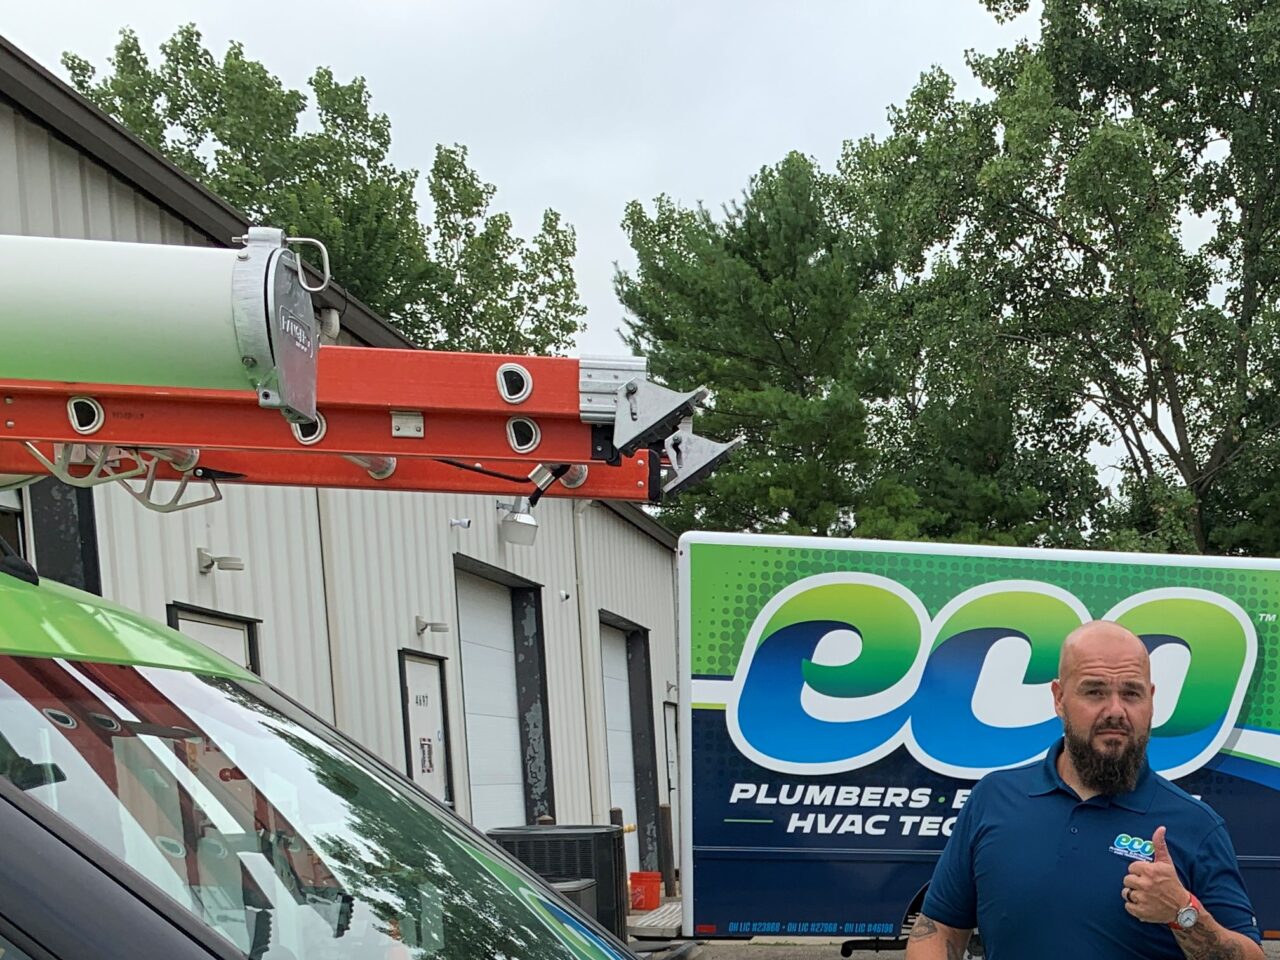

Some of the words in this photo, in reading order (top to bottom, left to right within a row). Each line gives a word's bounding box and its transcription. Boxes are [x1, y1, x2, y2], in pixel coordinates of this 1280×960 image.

[728, 573, 1256, 778] eco
[729, 783, 932, 808] PLUMBERS
[786, 813, 890, 835] HVAC
[1114, 834, 1155, 856] eco
